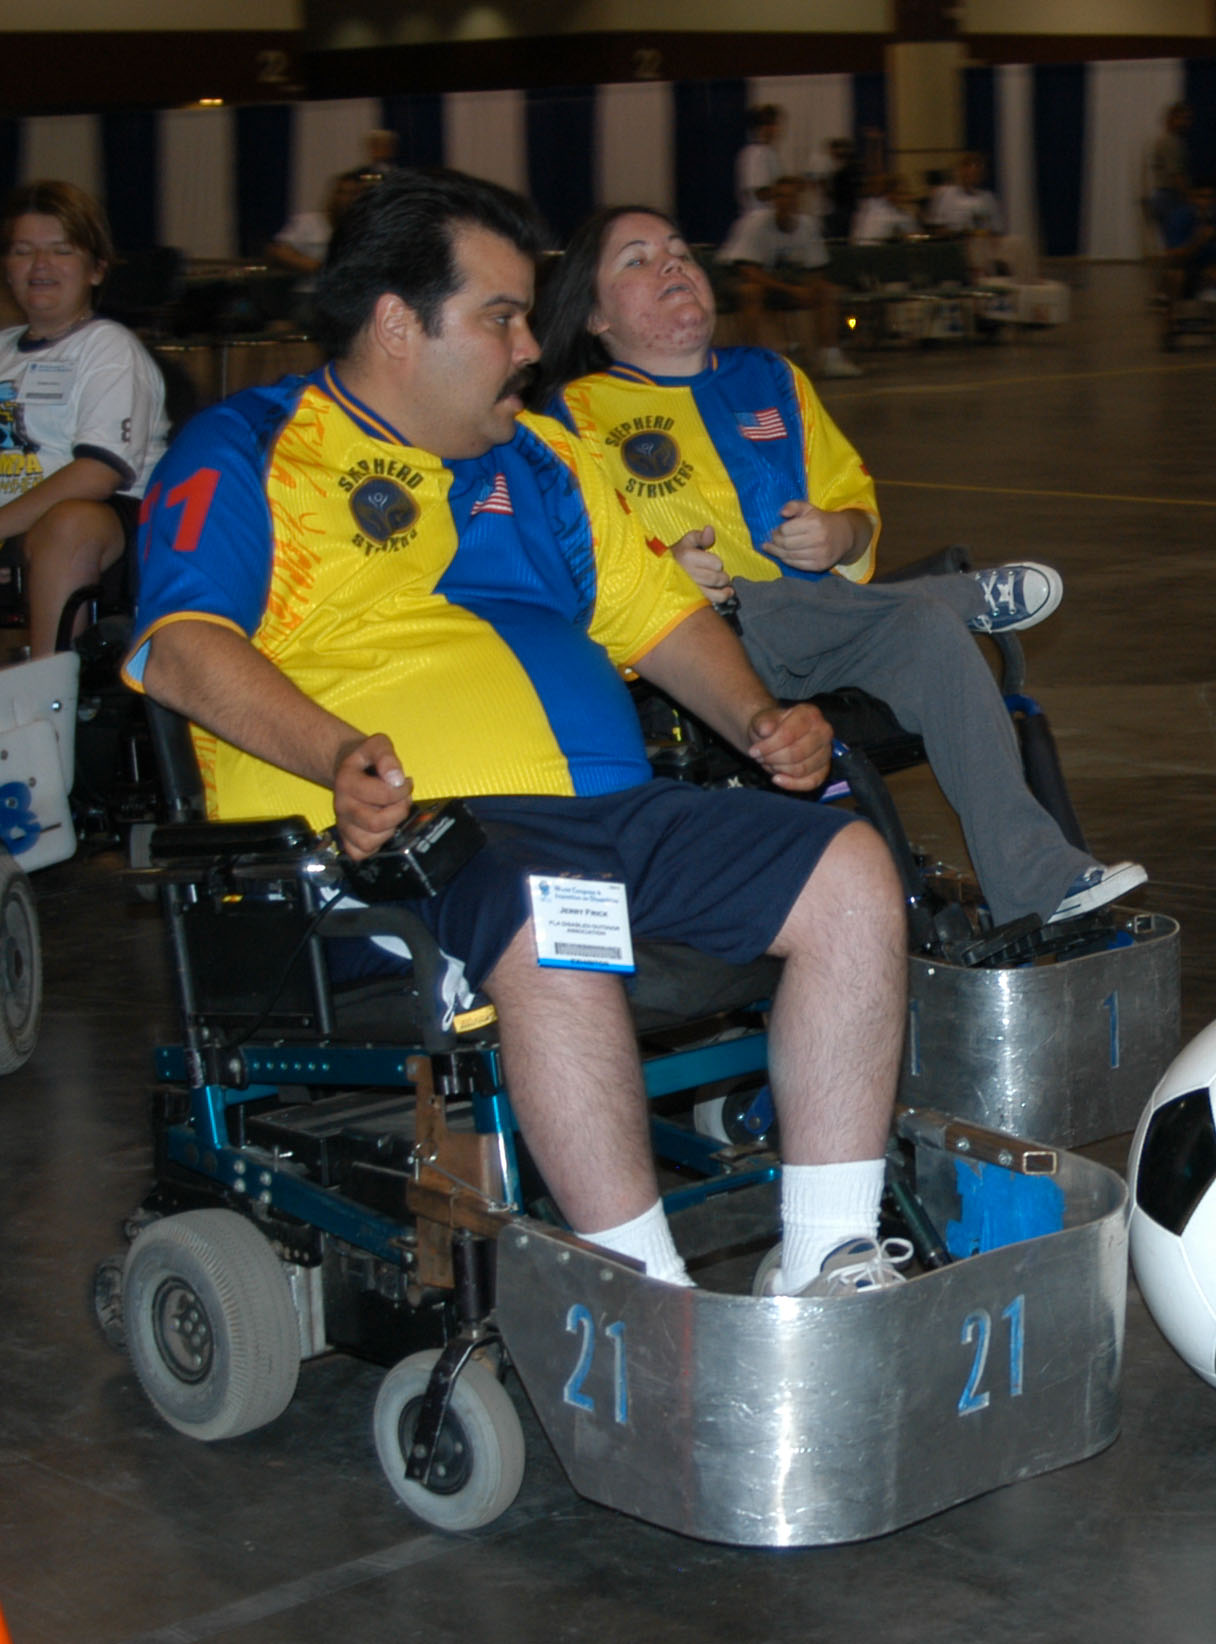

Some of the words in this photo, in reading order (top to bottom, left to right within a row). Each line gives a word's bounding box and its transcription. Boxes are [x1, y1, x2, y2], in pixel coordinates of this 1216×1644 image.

[625, 460, 694, 498] STRIKERS
[1103, 990, 1120, 1069] 1
[563, 1303, 629, 1424] 21
[957, 1293, 1025, 1417] 21
